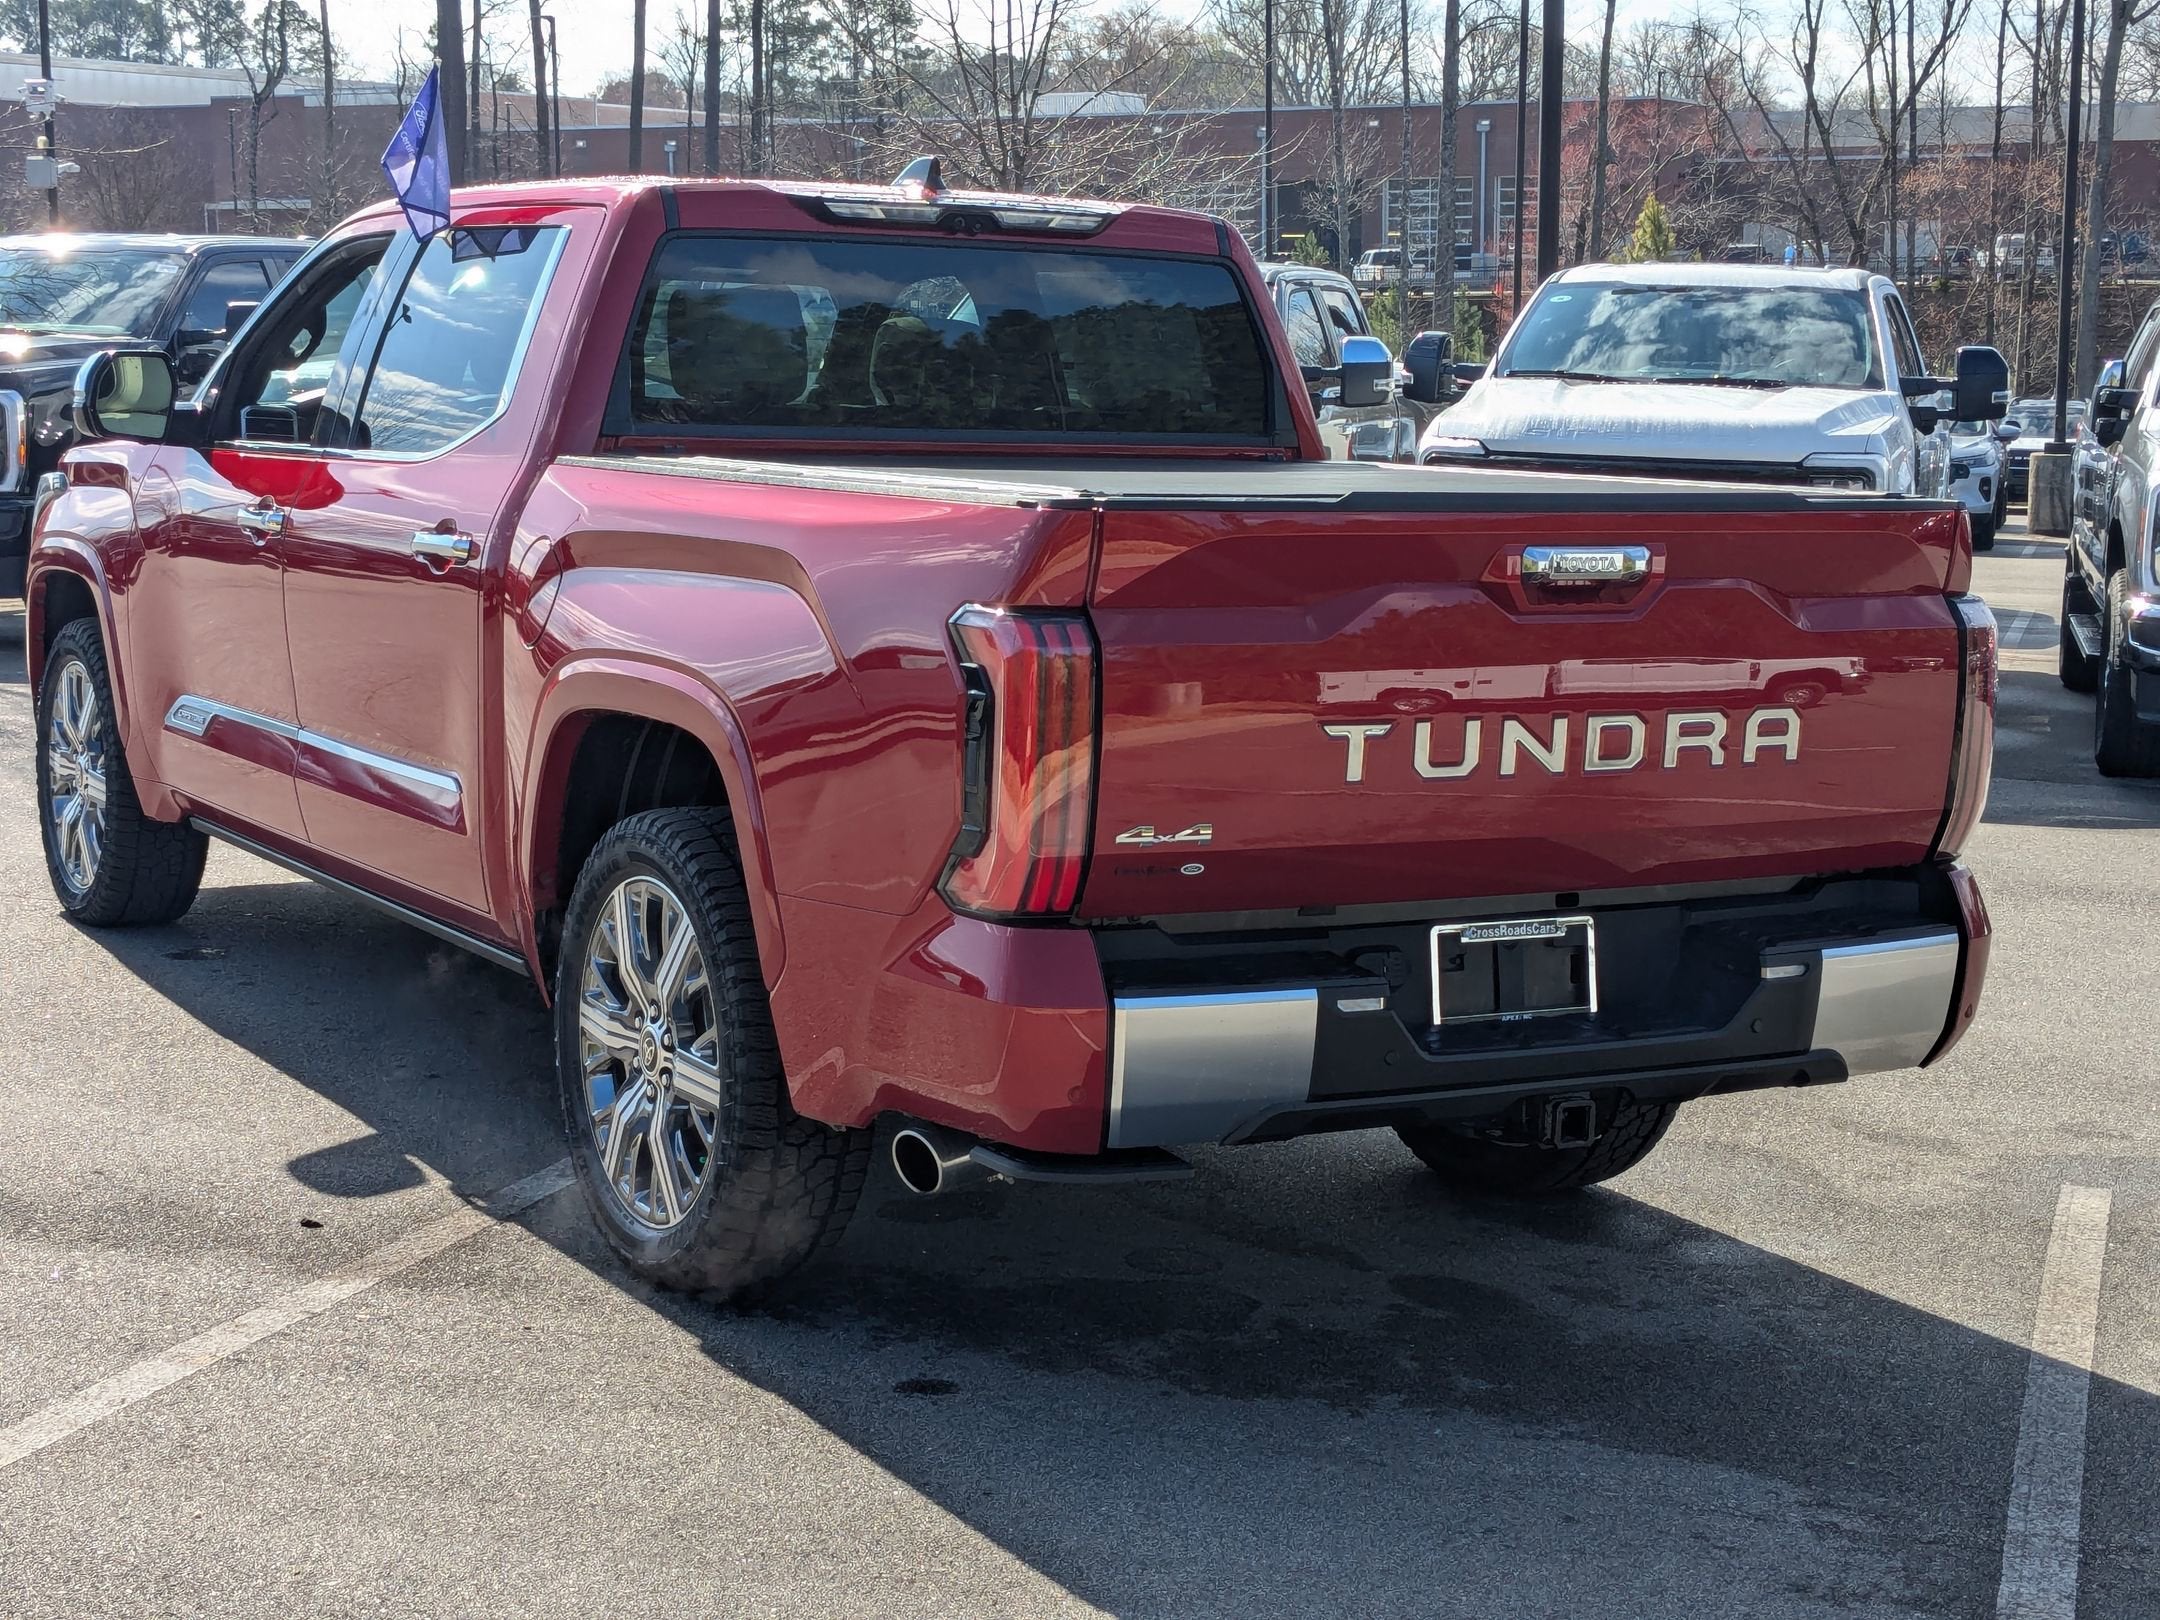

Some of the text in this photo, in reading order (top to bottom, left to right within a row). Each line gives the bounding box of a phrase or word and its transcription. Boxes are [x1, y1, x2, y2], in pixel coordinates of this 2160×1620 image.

[1559, 556, 1618, 573] TOYOTA
[1322, 707, 1801, 783] TUNDRA
[1115, 823, 1213, 847] 4x4
[1470, 922, 1556, 938] CrossRoadsCars
